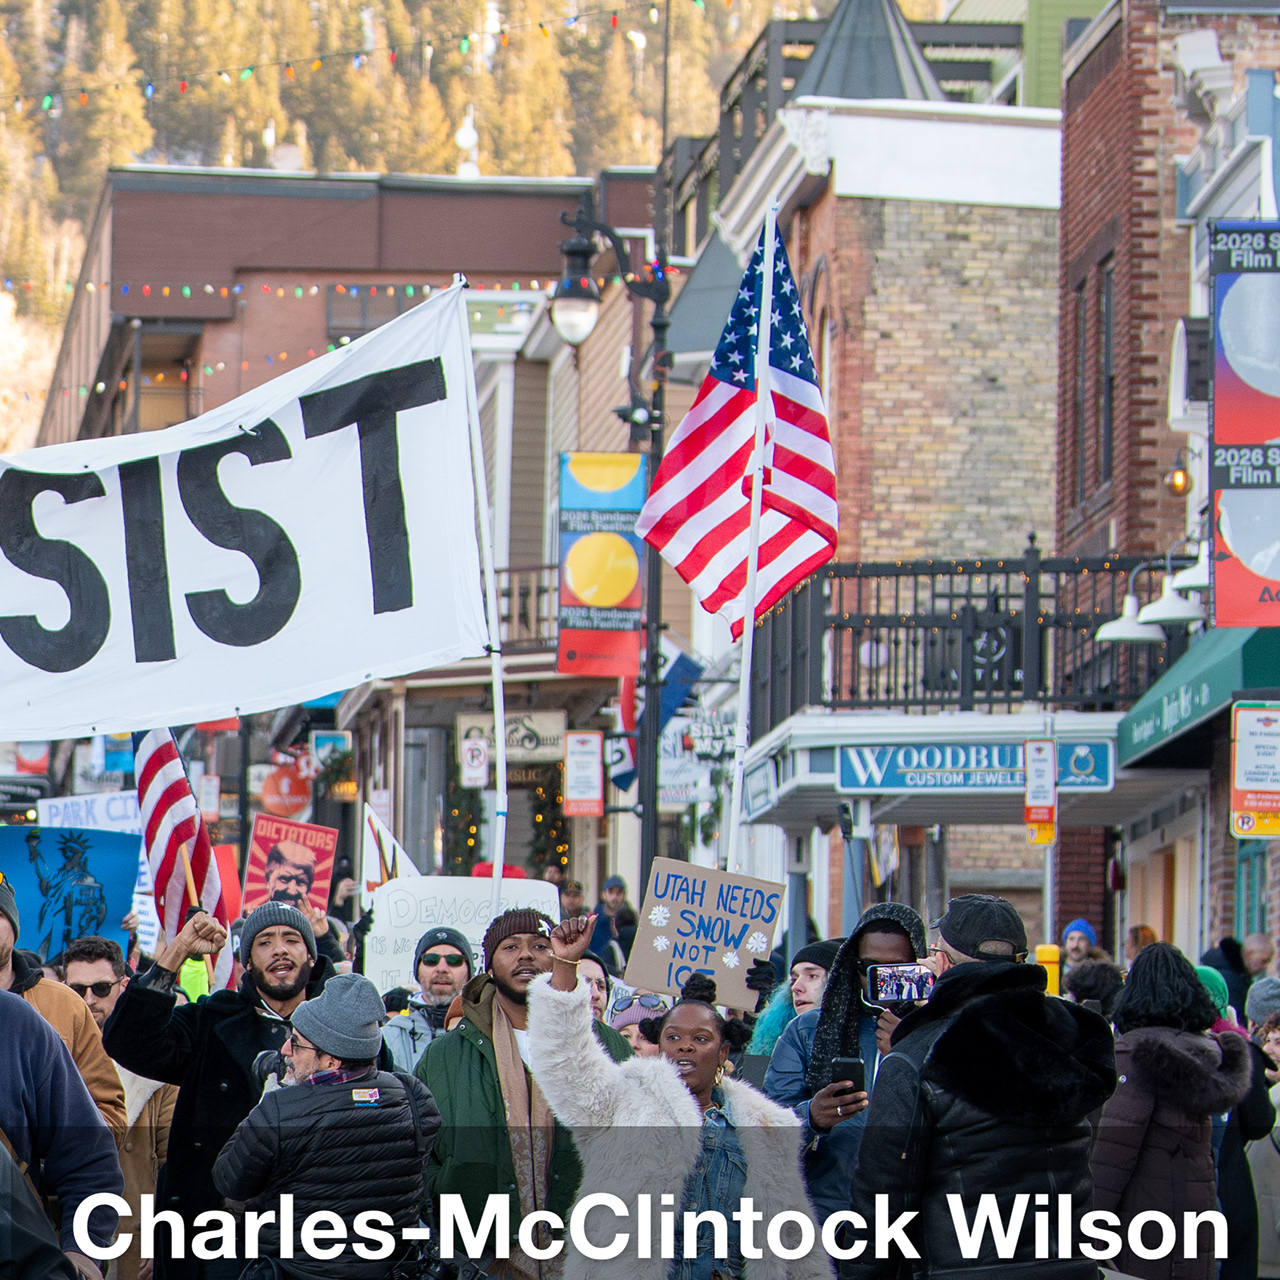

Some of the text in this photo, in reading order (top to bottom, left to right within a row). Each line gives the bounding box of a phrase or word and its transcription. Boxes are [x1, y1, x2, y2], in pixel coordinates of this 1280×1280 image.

[1216, 233, 1266, 251] 2026
[1230, 250, 1273, 268] Film
[1214, 448, 1264, 466] 2026
[1230, 466, 1272, 484] Film
[906, 771, 964, 786] CUSTOM
[48, 798, 98, 827] PARK
[256, 818, 336, 850] DICTATORS
[386, 888, 558, 928] DEMOCY
[653, 871, 781, 924] UTAH NEEDS
[676, 908, 751, 950] SNOW
[671, 941, 717, 966] NOT
[667, 961, 716, 988] IC
